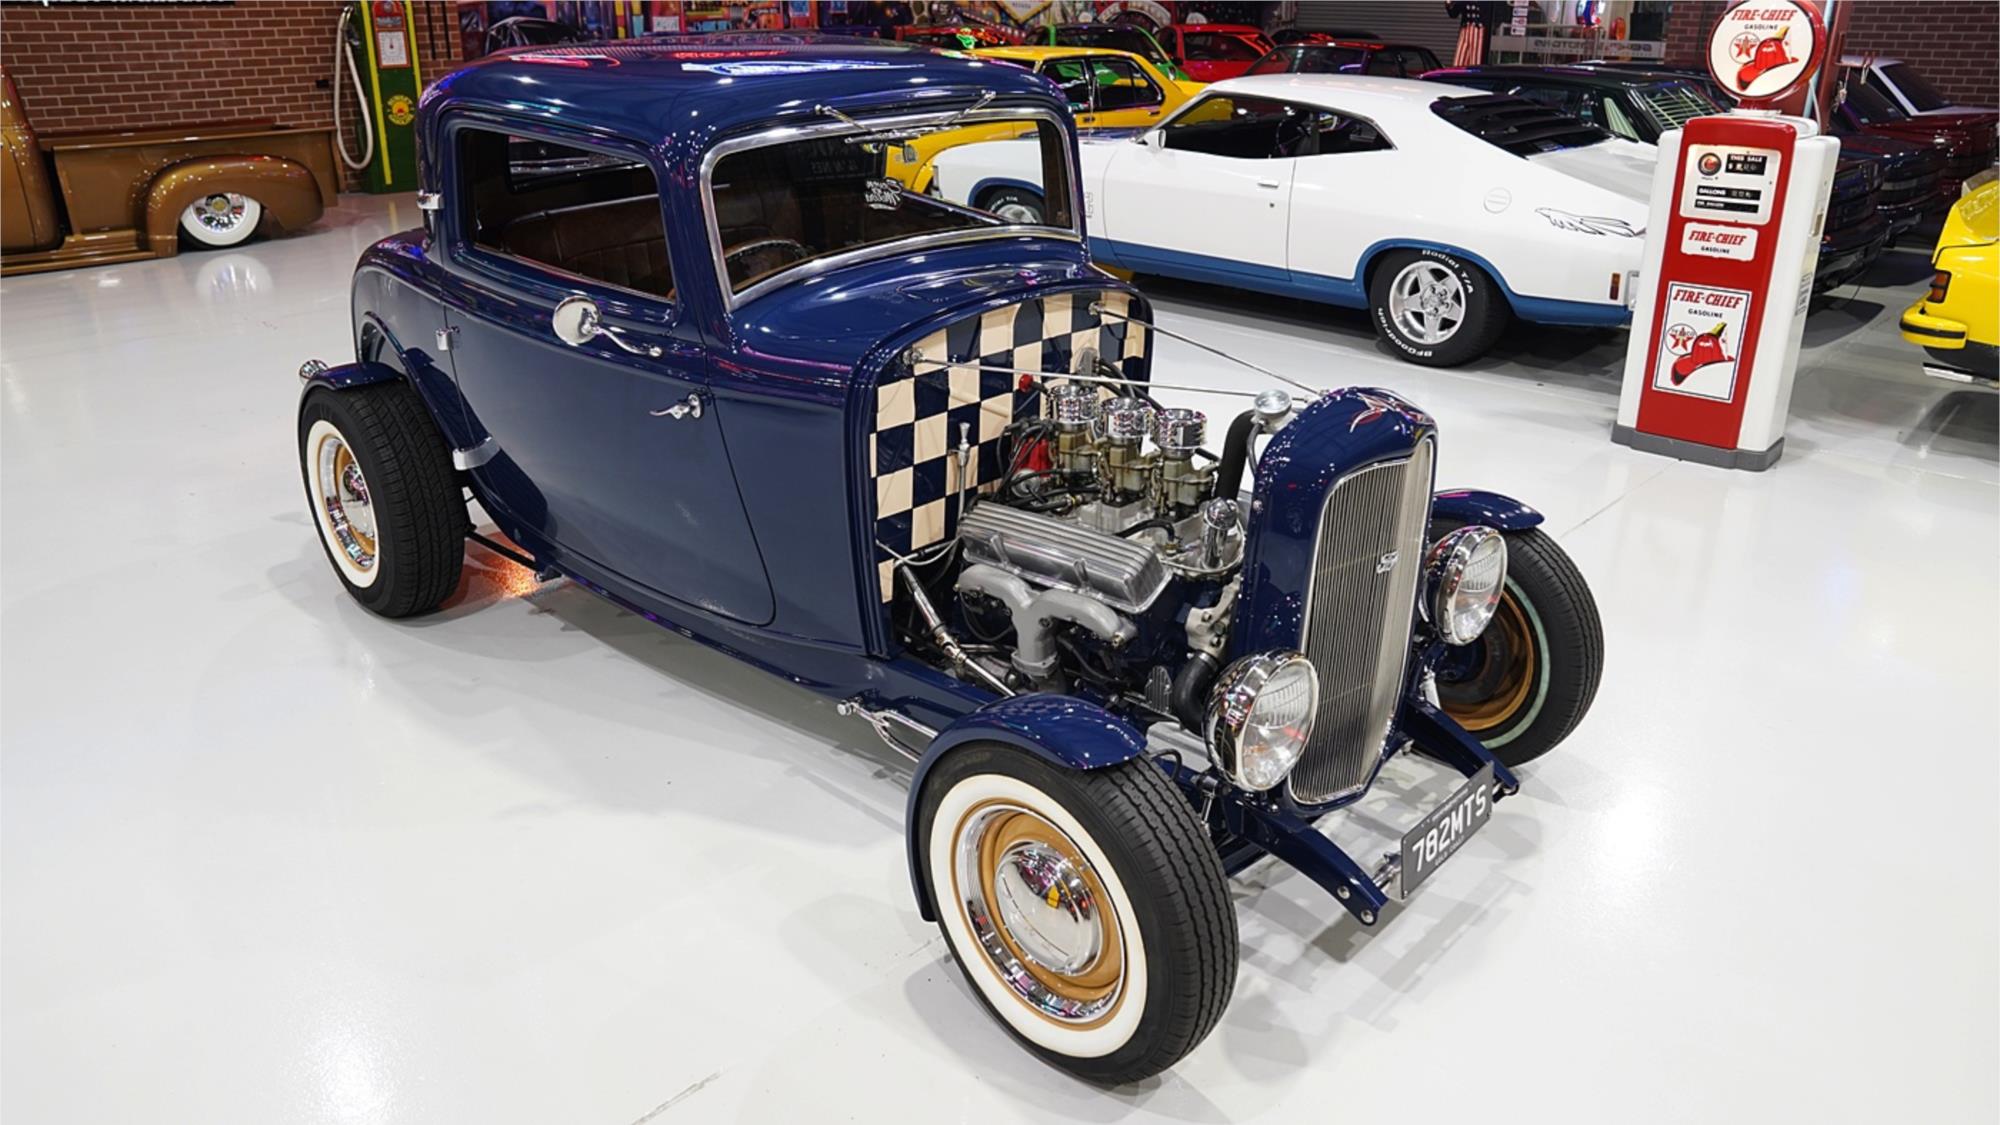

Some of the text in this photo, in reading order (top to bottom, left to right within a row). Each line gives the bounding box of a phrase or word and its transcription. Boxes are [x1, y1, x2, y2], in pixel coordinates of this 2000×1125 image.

[1731, 9, 1797, 21] FIRE-CHIEF
[1688, 230, 1747, 245] FIRE-CHIEF
[1701, 245, 1730, 254] GASOLINE
[1422, 249, 1460, 268] Radial
[1673, 289, 1743, 309] FIRE-CHIEF
[1688, 308, 1723, 318] GASOLINE
[1412, 784, 1487, 872] 782MTS
